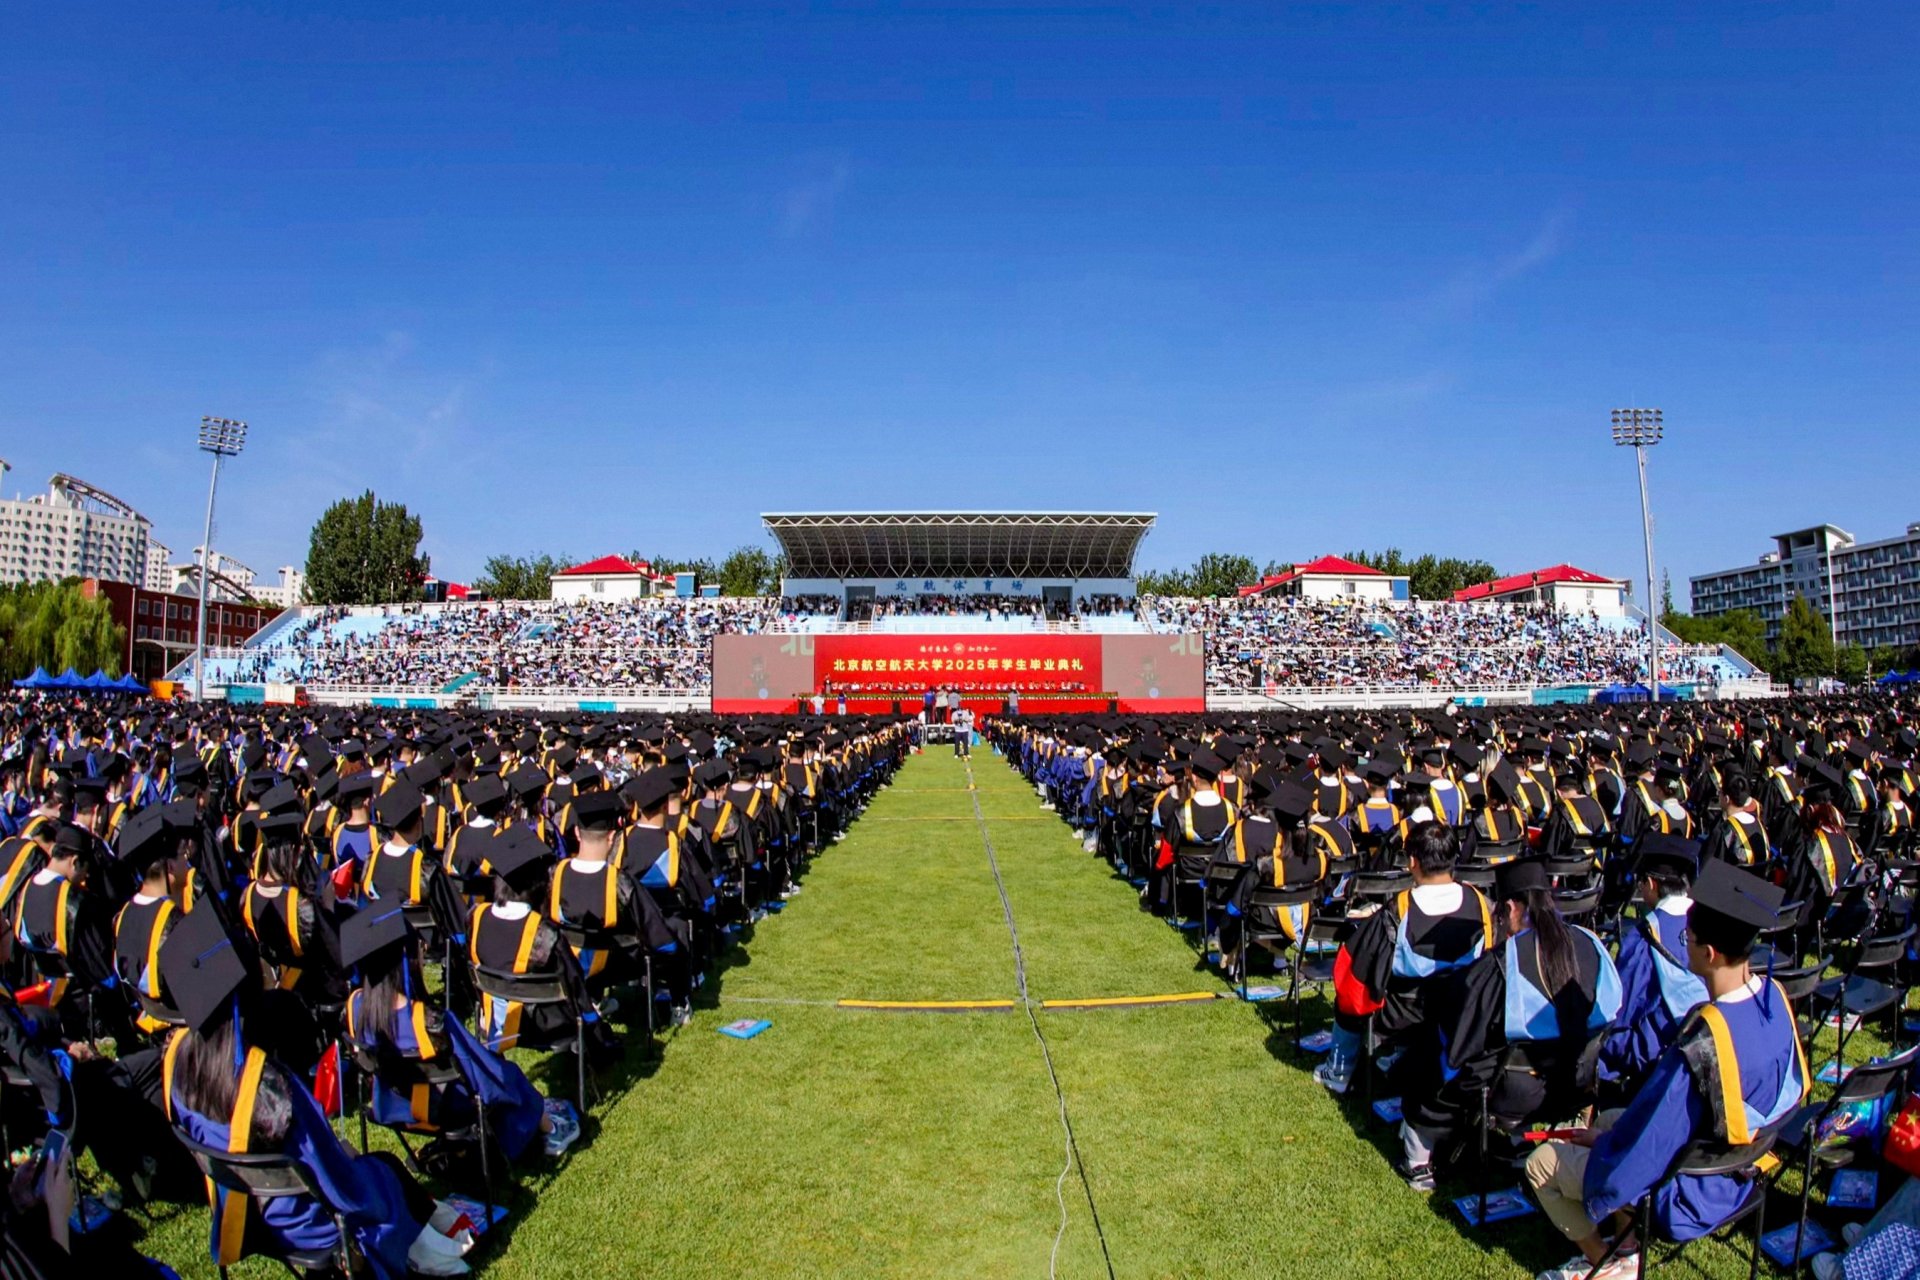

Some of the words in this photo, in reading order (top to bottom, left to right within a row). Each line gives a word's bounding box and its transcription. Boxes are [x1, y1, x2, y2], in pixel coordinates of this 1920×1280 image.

[896, 579, 1023, 592] 北航体育场
[833, 658, 1084, 671] 北京航空航天大学2025年学生毕业典礼
